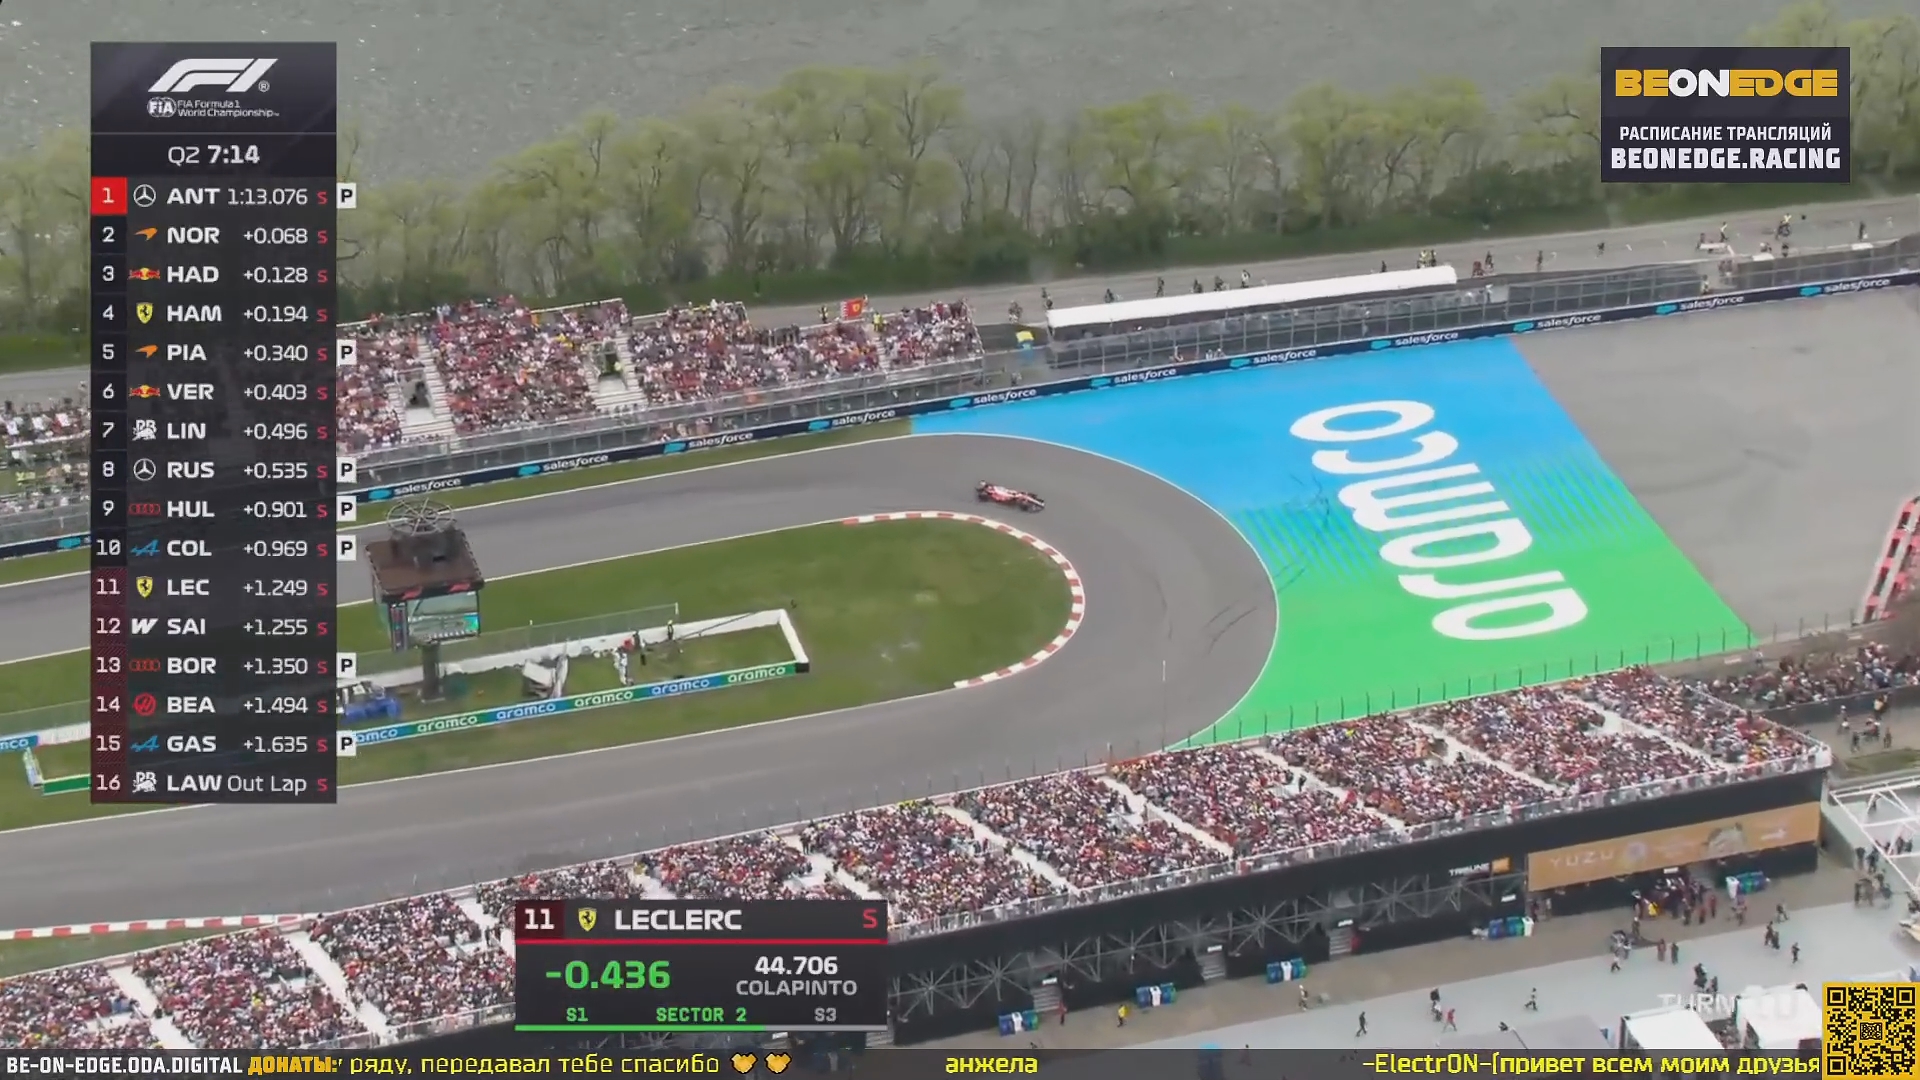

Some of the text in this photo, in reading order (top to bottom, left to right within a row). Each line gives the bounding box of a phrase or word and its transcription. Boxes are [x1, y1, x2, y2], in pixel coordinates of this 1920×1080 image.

[1823, 277, 1890, 294] salesforce
[1679, 294, 1744, 311] salesforce
[1537, 313, 1602, 329] salesforce
[1395, 331, 1459, 347] salesforce
[1253, 348, 1317, 364] salesforce
[1113, 367, 1177, 384] salesforce
[973, 388, 1037, 404] salesforce
[832, 409, 896, 426] salesforce
[688, 431, 754, 449] salesforce
[542, 454, 609, 472] salesforce
[394, 477, 461, 496] salesforce
[1289, 400, 1588, 640] aramco
[727, 666, 786, 683] aramco
[651, 678, 710, 695] aramco
[574, 691, 634, 707] aramco
[496, 702, 556, 720] aramco
[417, 716, 477, 732] aramco
[355, 728, 398, 743] amco
